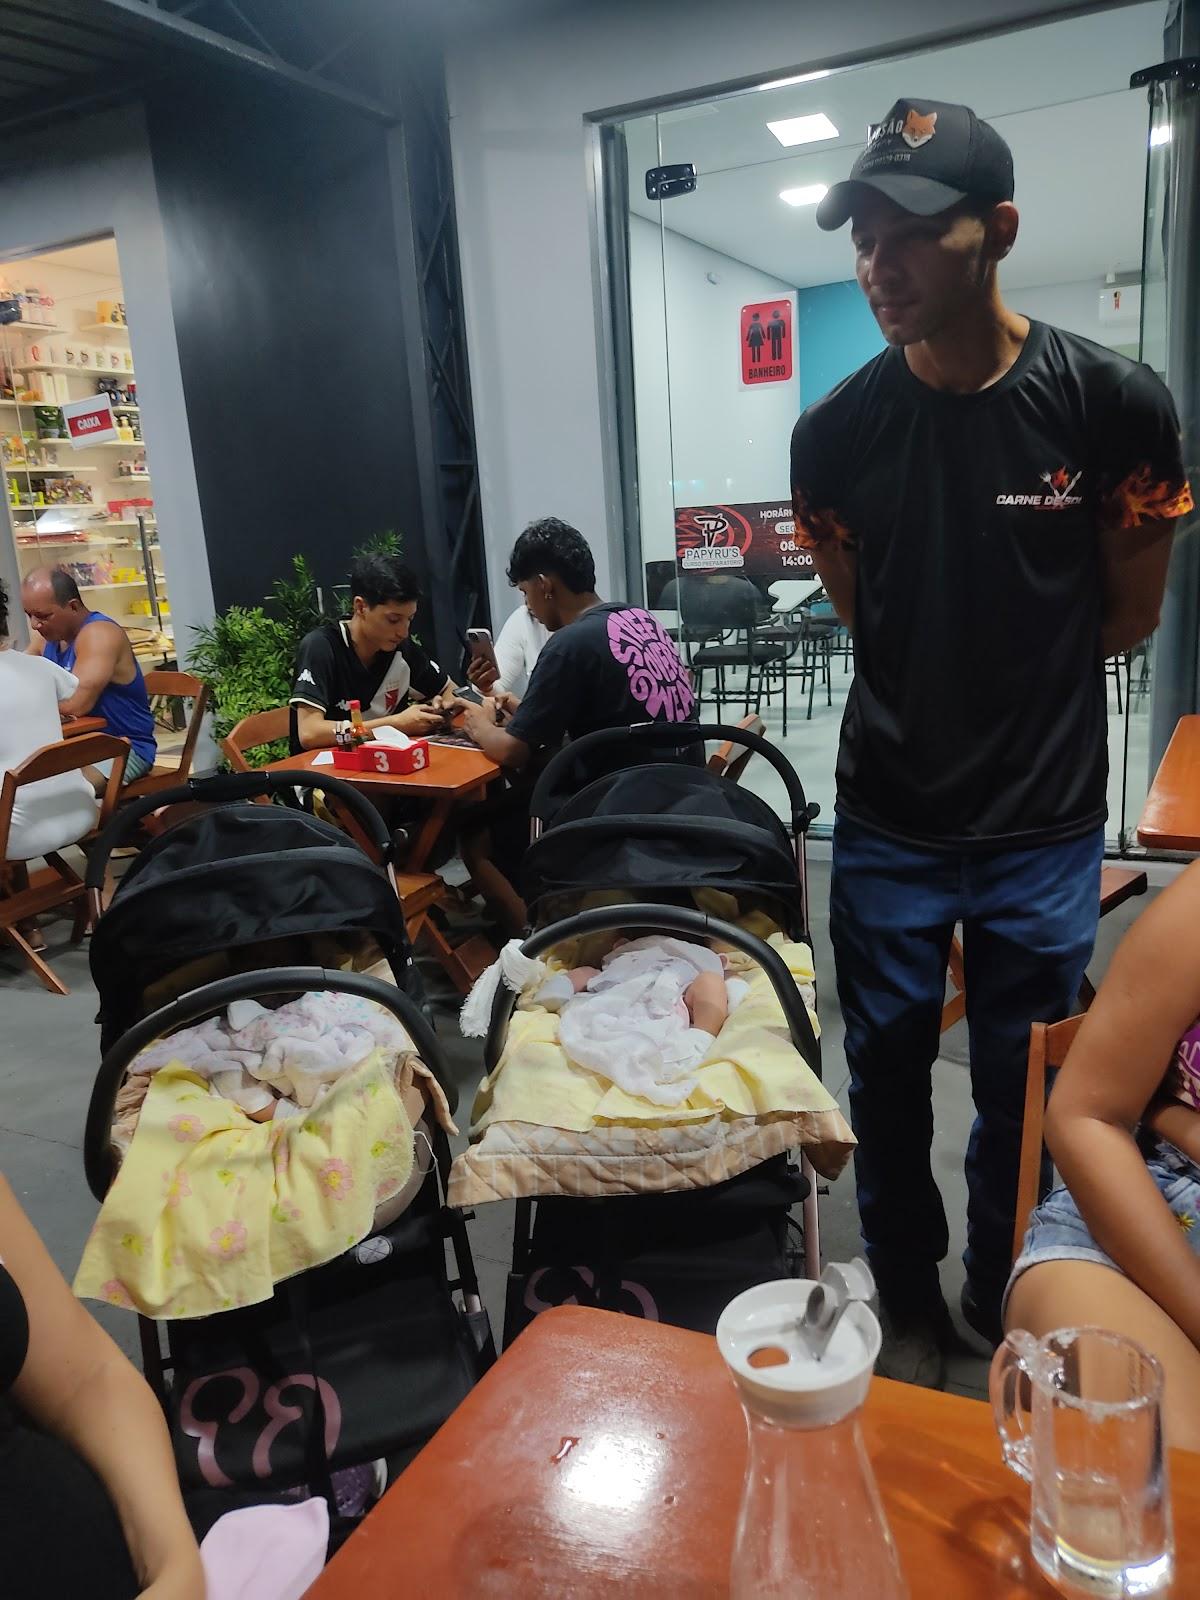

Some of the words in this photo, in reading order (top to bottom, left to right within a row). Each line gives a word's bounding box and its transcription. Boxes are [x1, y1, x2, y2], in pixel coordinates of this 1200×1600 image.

[748, 364, 785, 380] BANHEIRO
[77, 415, 101, 431] CAIXA
[996, 494, 1042, 505] CARNE
[760, 507, 794, 519] HORÁRI
[686, 548, 739, 560] PAPYRU'S
[781, 555, 813, 567] 14:00
[374, 751, 390, 772] 3
[412, 748, 425, 770] 3
